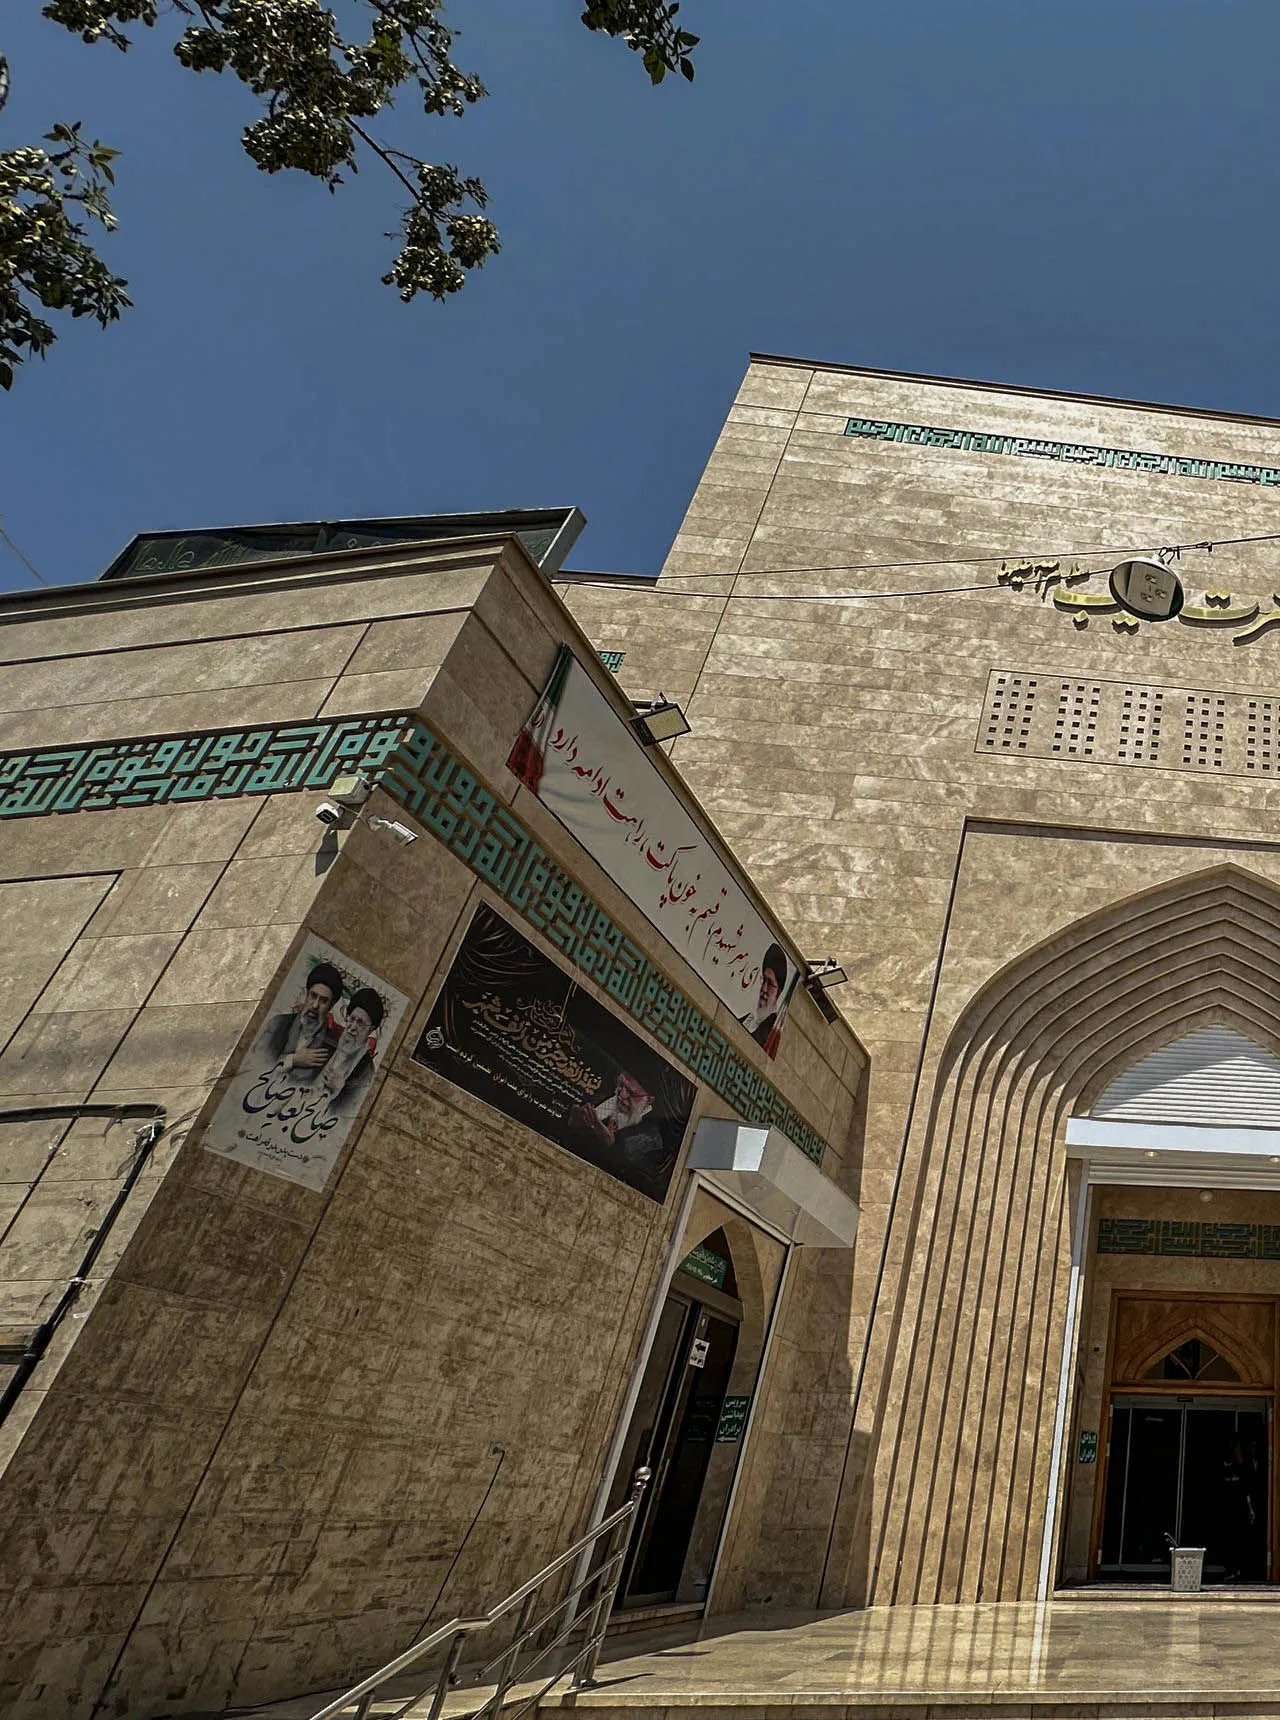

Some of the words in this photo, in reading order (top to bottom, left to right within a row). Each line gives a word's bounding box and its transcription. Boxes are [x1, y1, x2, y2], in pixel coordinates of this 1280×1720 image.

[550, 727, 579, 763] دارد
[571, 765, 611, 797] ادامه
[602, 787, 645, 844] راهت
[669, 873, 701, 902] خون
[687, 887, 727, 945] قسم
[728, 951, 749, 979] رهبر
[741, 966, 760, 989] ای
[241, 1061, 296, 1114] صالح
[721, 1409, 745, 1422] بهداشتی
[725, 1399, 747, 1408] سرویس
[719, 1423, 742, 1436] برادران
